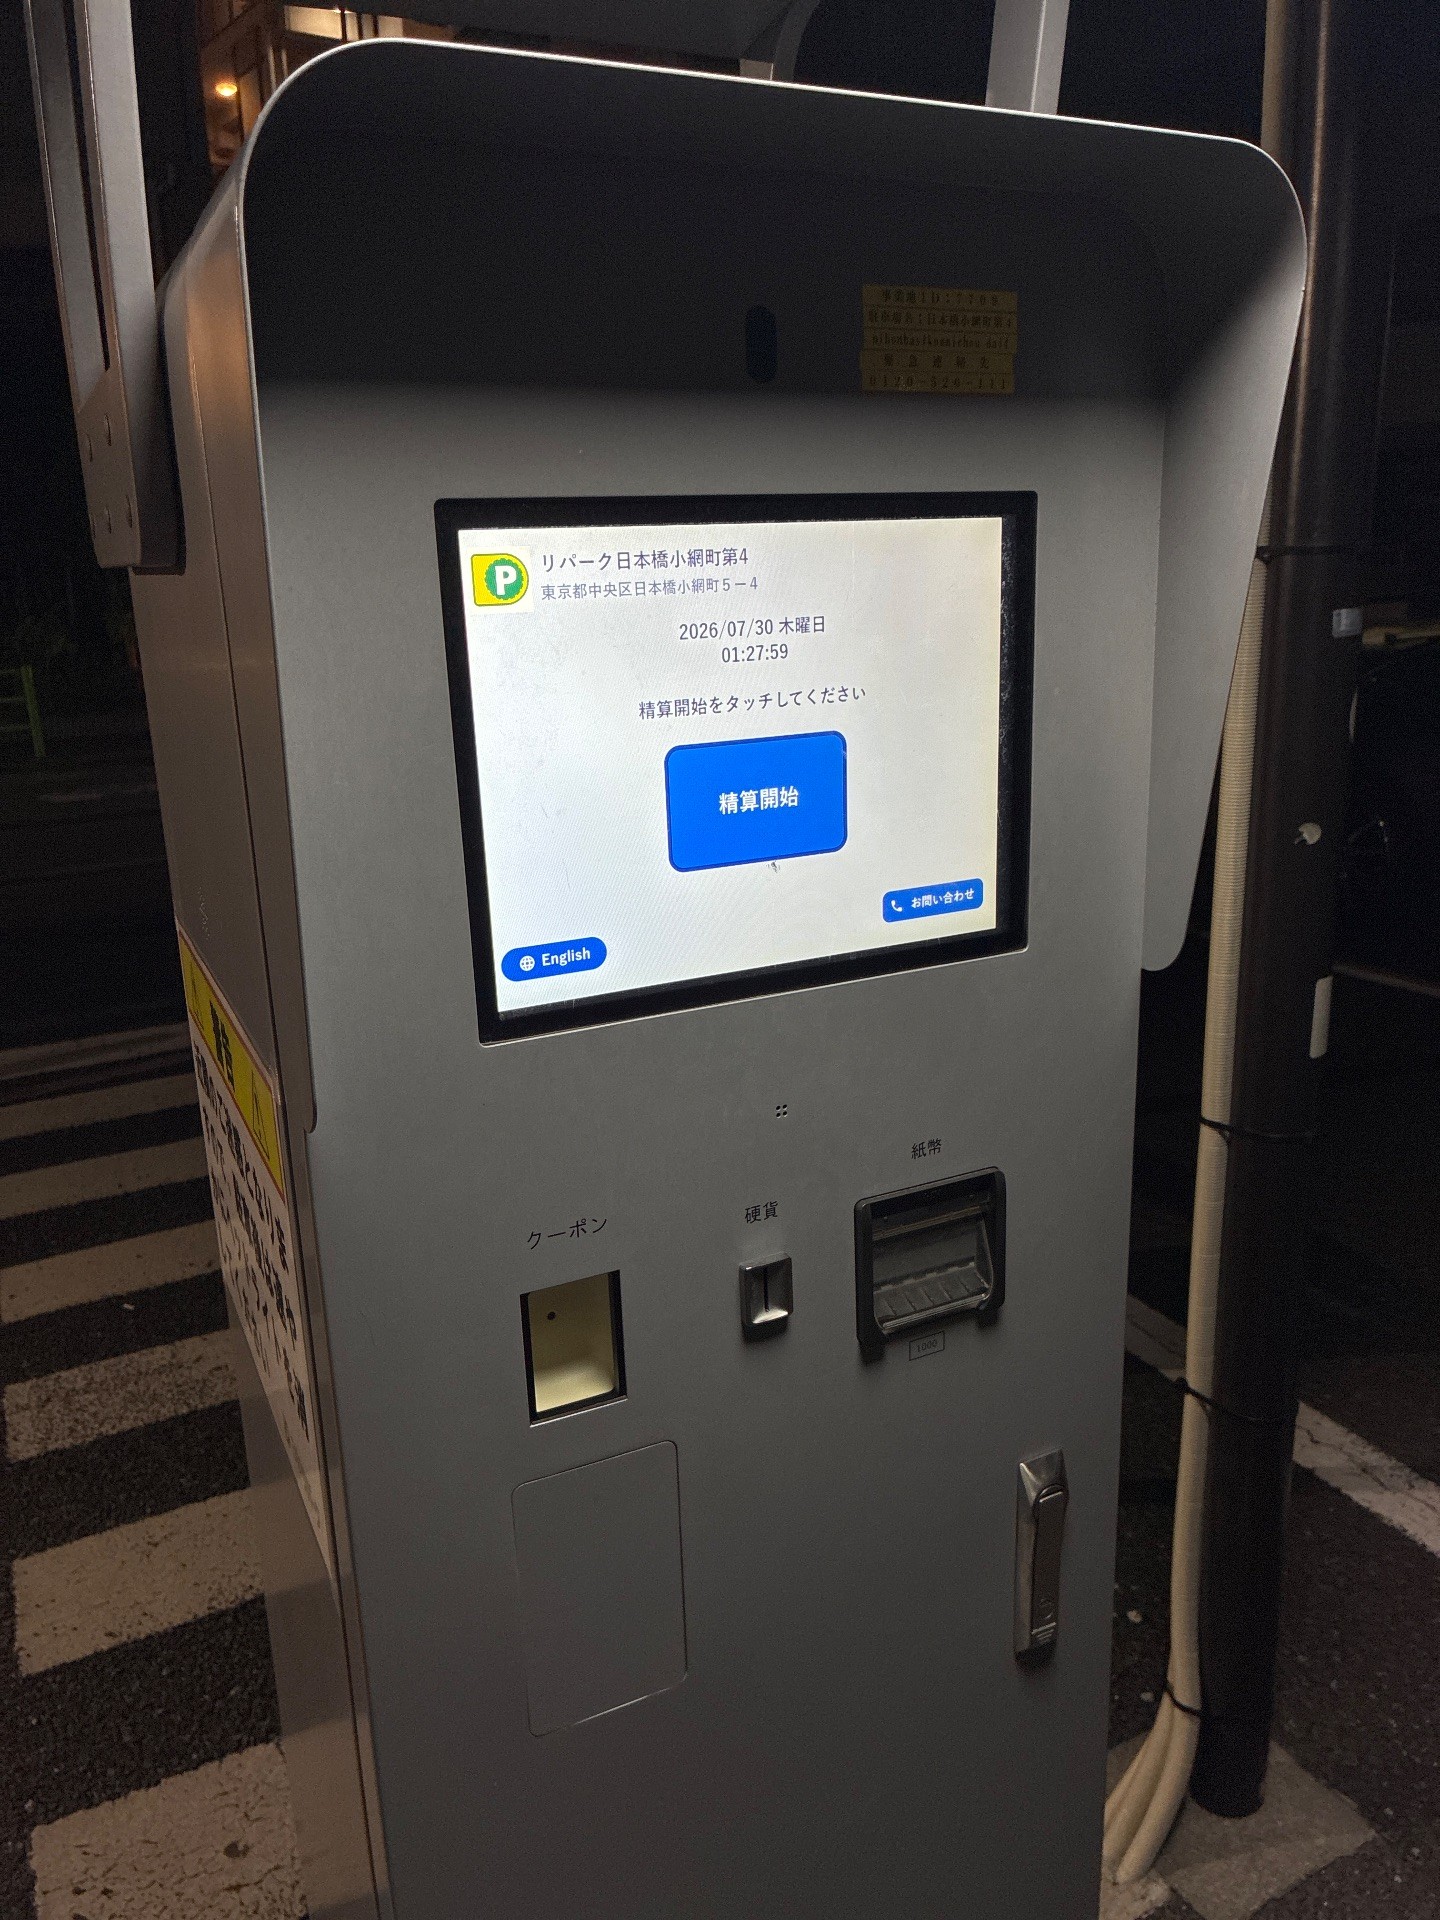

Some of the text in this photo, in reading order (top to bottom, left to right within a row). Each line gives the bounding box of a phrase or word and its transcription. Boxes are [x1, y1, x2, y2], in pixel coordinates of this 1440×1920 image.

[541, 547, 749, 574] リパーク日本橋小網町第4
[679, 615, 827, 641] 2026/07/30 木曜日
[721, 644, 789, 664] 01:27:59
[638, 686, 867, 720] 精算開始をタッチしてください
[717, 785, 801, 814] 精算開始
[910, 888, 976, 910] お問い合わせ
[541, 947, 593, 971] English
[912, 1138, 945, 1160] 紙幣
[744, 1201, 780, 1225] 硬貨
[526, 1216, 610, 1251] クーポン
